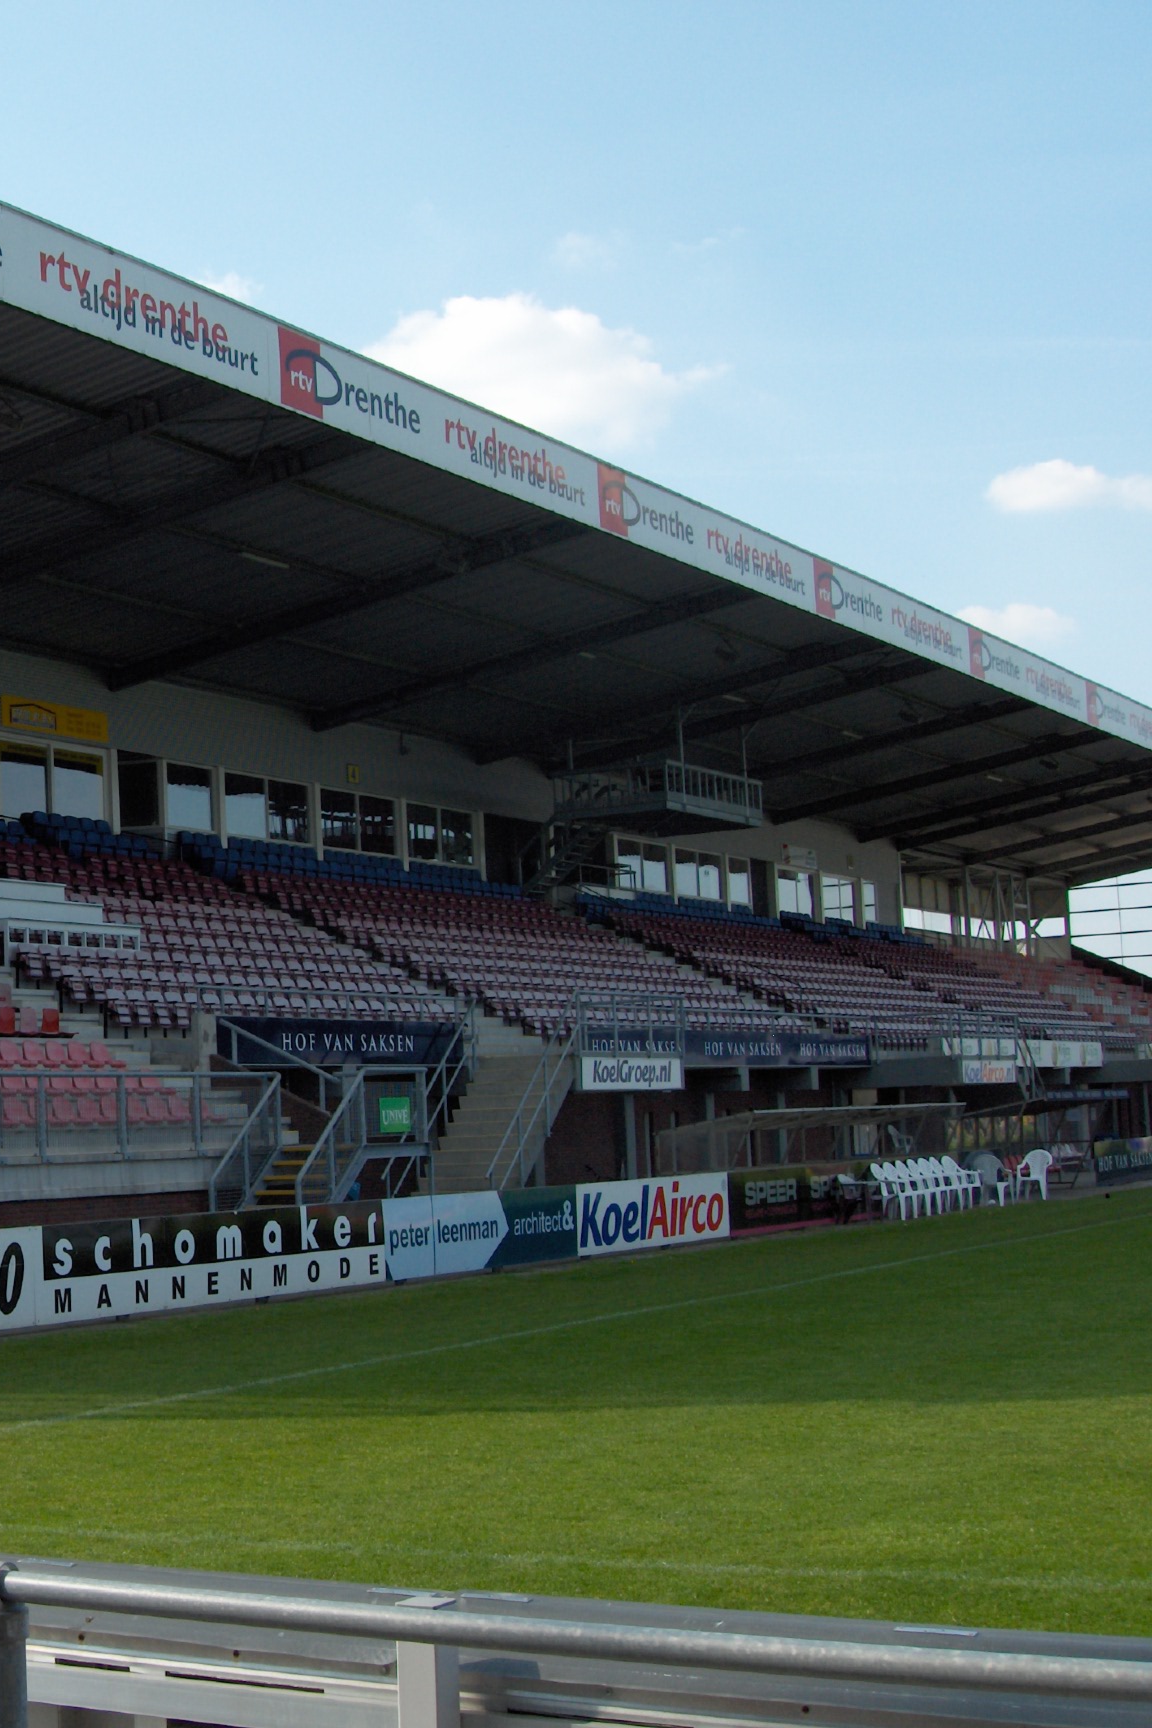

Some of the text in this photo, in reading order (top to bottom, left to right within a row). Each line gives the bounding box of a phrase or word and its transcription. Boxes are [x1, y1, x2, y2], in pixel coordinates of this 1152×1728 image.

[39, 251, 228, 353] rtv drenthe
[80, 284, 259, 376] altijd in de buurt
[286, 349, 421, 435] rtv Drenthe
[445, 418, 566, 490] rtv drenthe
[548, 469, 585, 506] buurt
[603, 480, 694, 545] rtv Drenthe
[281, 1032, 415, 1053] HOF VAN SAKSEN
[619, 1040, 641, 1052] VAN
[704, 1041, 782, 1057] HOF VAN SAKSEN
[799, 1041, 866, 1058] HOF VAN SAKSEN
[592, 1059, 671, 1087] KoelGroep.nl
[381, 1105, 409, 1126] UNIVÉ
[745, 1178, 797, 1206] SPEER
[580, 1181, 724, 1248] KoelAirco
[52, 1206, 376, 1277] schomaker
[389, 1218, 499, 1255] peter leenman
[54, 1253, 380, 1314] MANNENMODE
